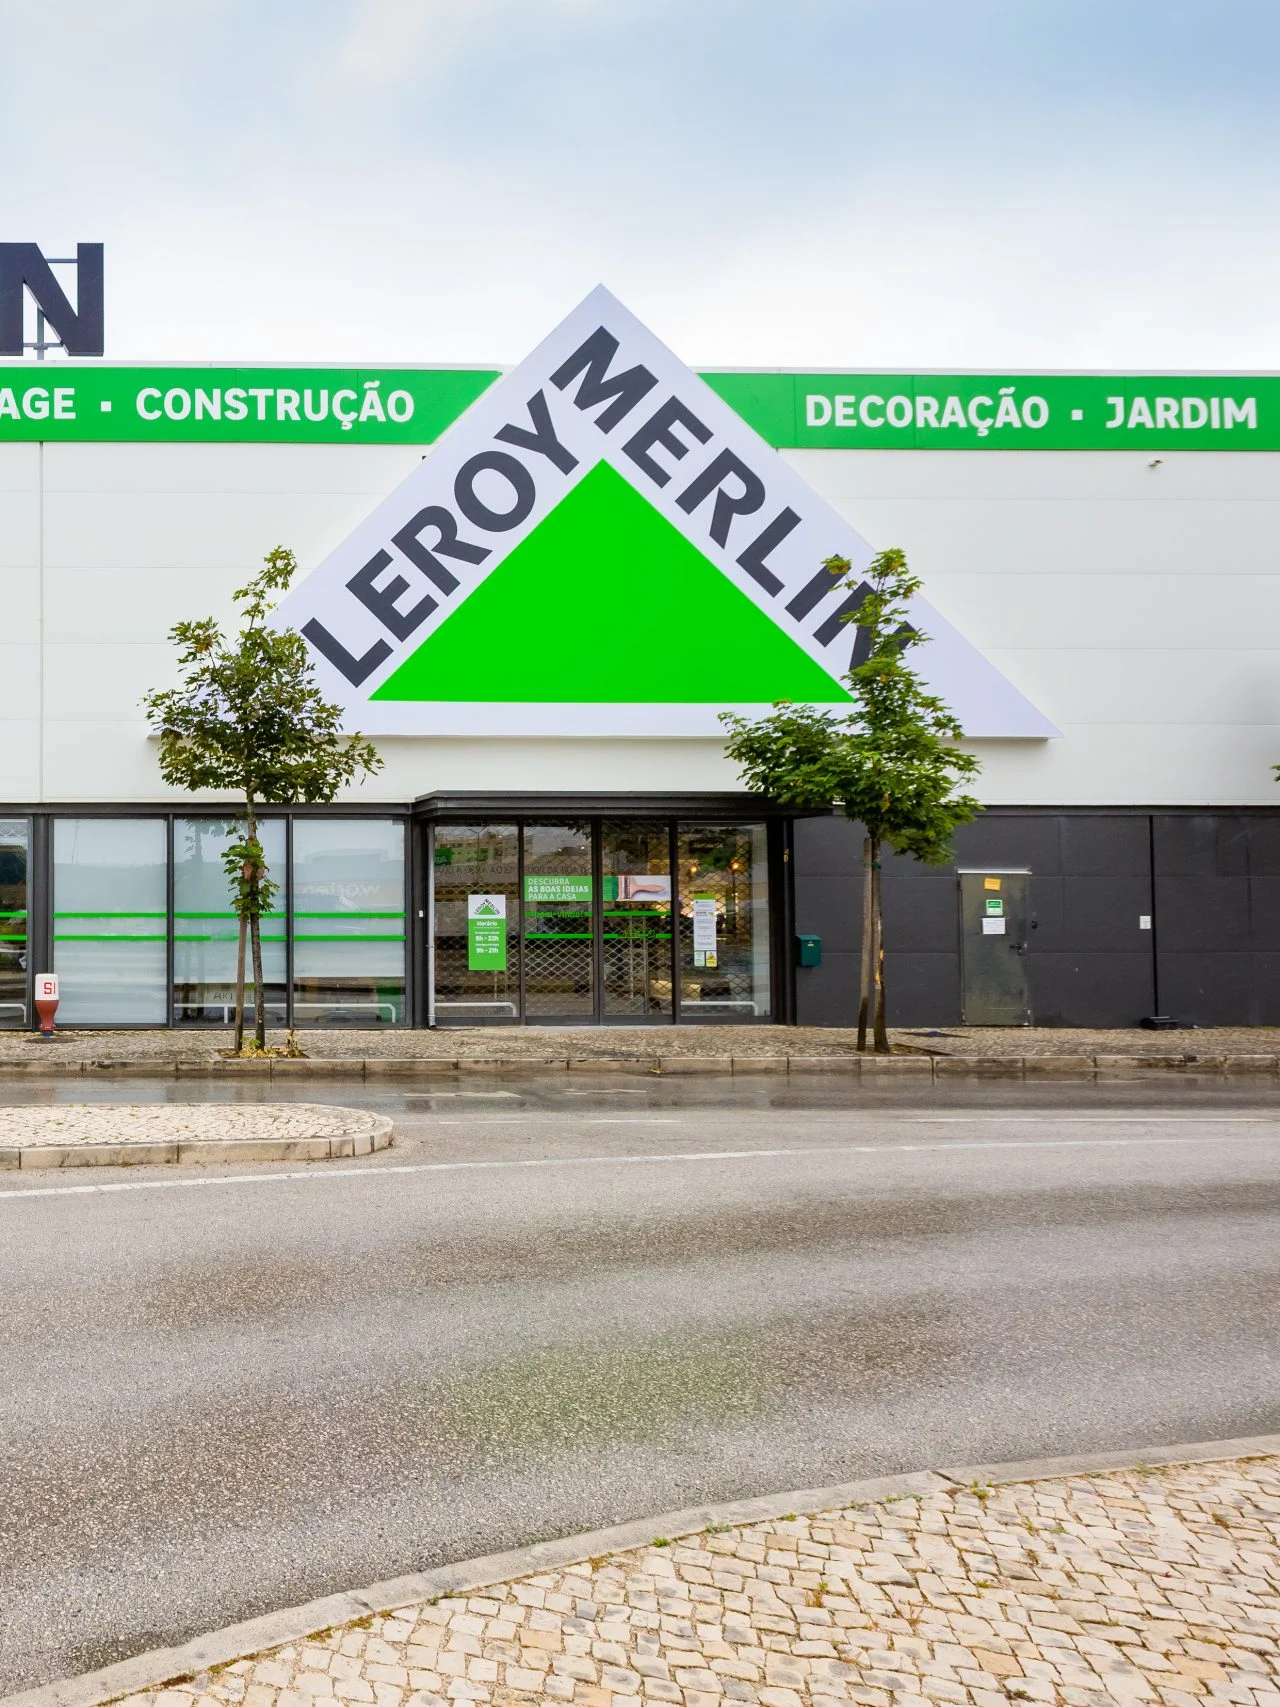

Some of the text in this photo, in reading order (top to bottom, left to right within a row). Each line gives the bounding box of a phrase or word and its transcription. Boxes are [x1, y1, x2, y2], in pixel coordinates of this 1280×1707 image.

[134, 381, 415, 430] CONSTRUÇÃO
[804, 386, 1258, 436] DECORAÇÃO JARDIM
[301, 388, 580, 689] LEROY
[528, 885, 589, 893] AS BOAS IDEIAS
